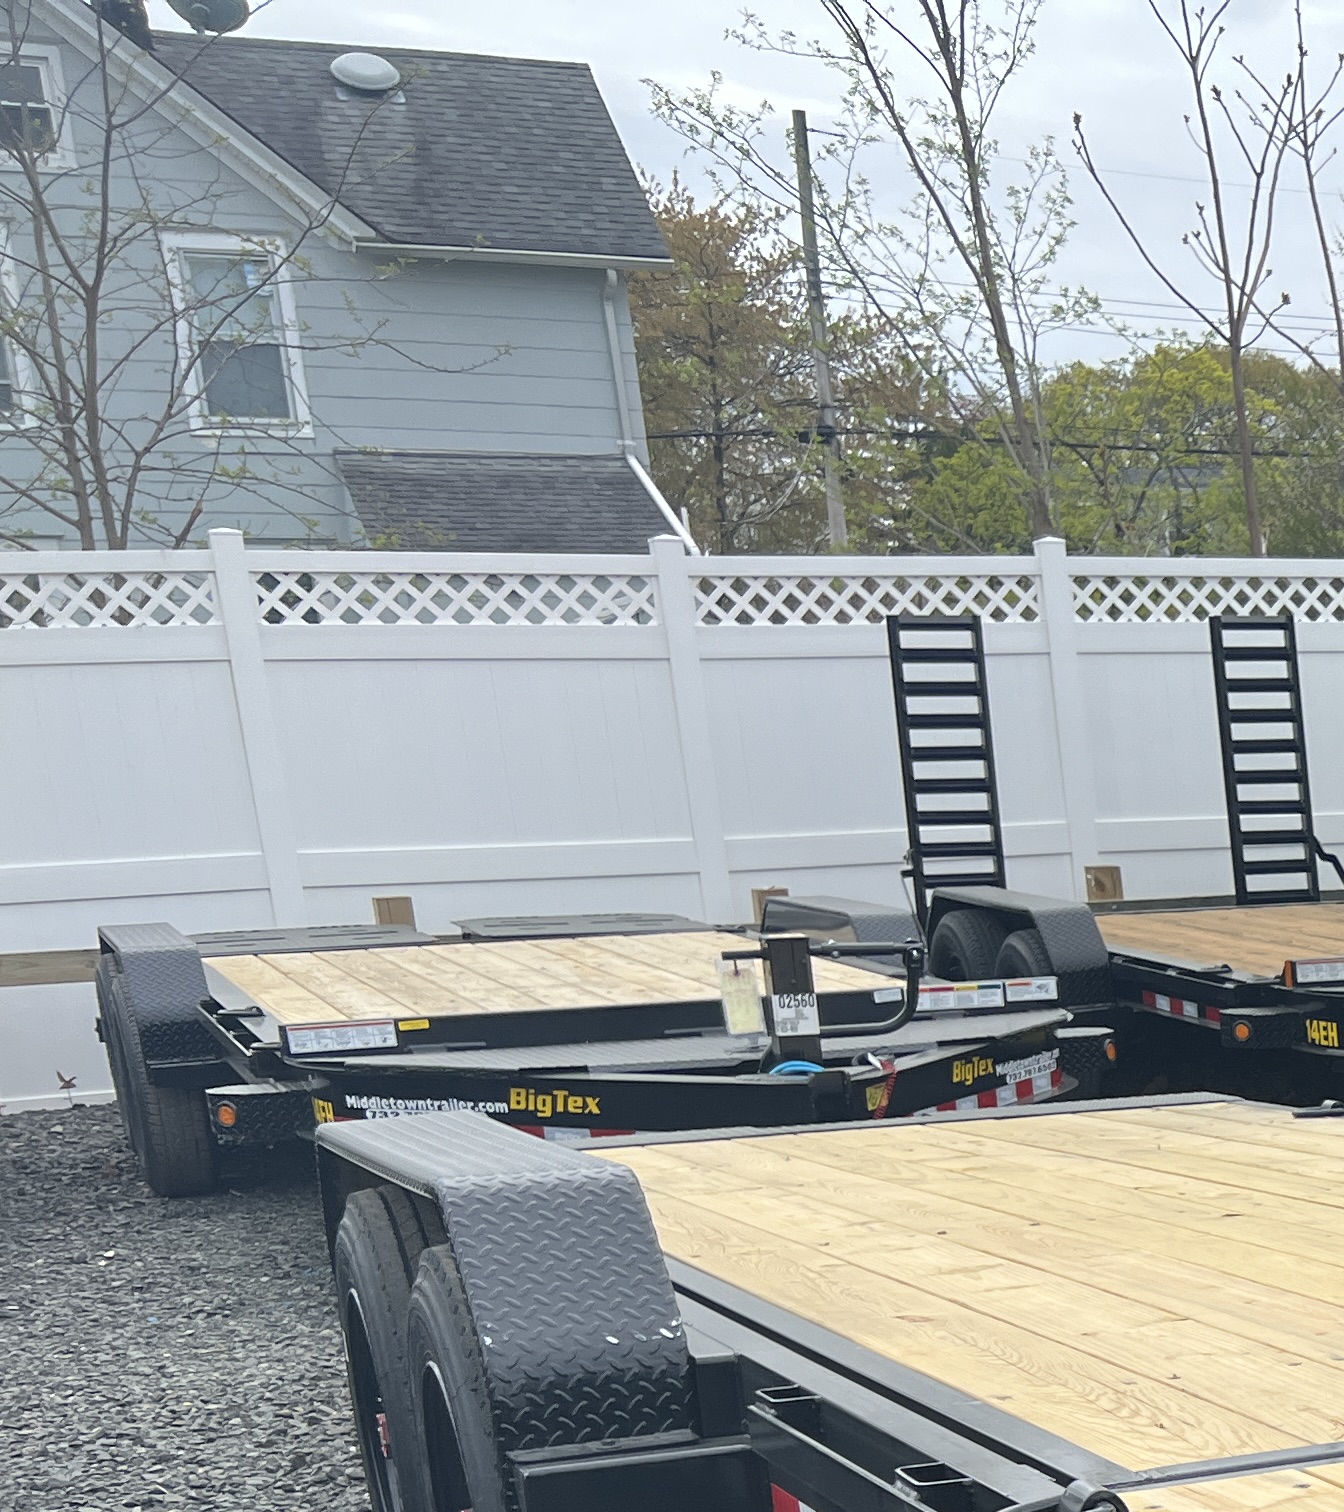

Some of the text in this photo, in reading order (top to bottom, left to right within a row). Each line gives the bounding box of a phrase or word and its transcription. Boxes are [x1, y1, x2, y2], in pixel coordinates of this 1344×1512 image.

[1305, 1018, 1340, 1048] 14EH
[952, 1056, 994, 1086] BigTex
[345, 1094, 509, 1114] Middletowntrailer.com
[509, 1087, 600, 1118] BigTex
